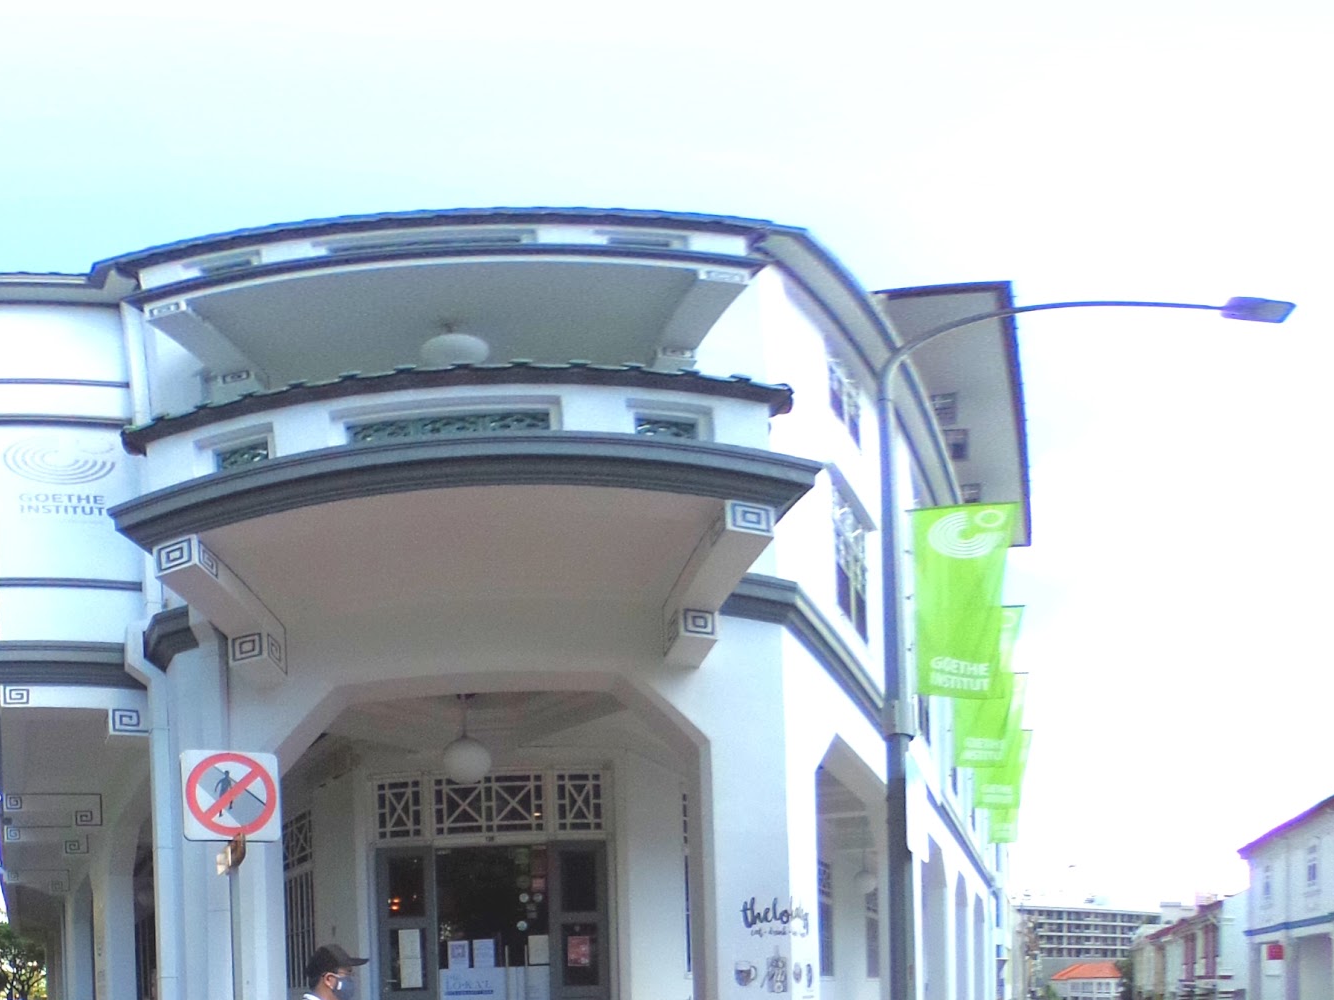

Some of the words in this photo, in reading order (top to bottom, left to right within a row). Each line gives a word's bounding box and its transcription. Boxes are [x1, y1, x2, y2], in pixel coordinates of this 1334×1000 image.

[19, 493, 105, 505] GOETHE
[19, 504, 105, 516] INSTITUT
[930, 656, 990, 676] GOETHE
[929, 672, 989, 691] INSTITUT
